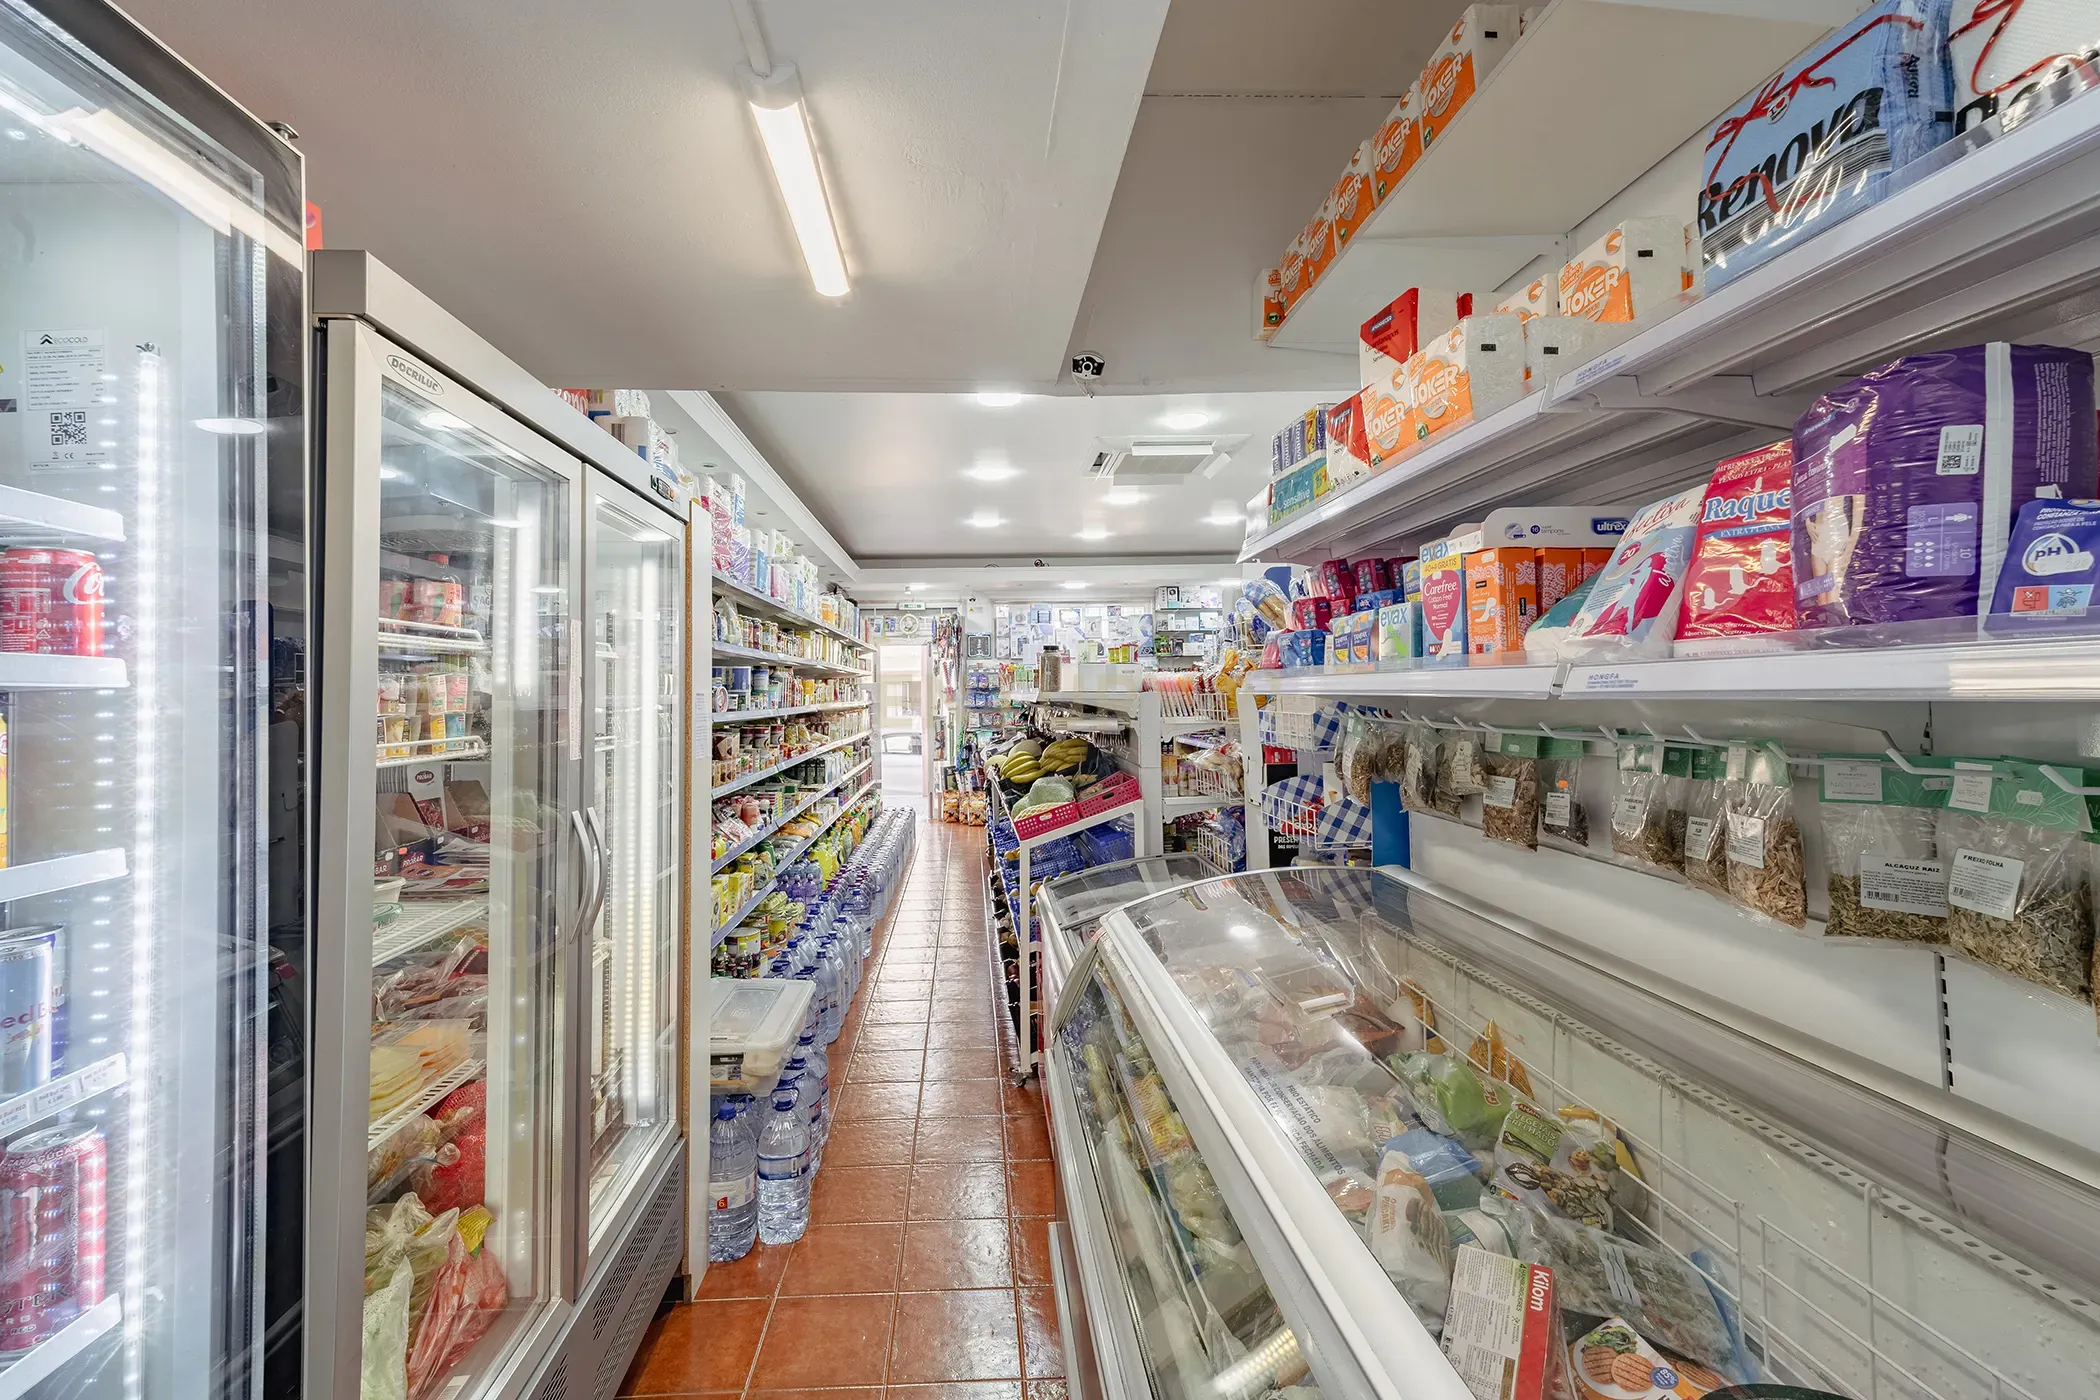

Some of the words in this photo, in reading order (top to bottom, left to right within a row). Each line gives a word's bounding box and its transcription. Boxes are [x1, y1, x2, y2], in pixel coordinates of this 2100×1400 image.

[1422, 53, 1463, 117] JOKER
[1374, 118, 1411, 172] JOKER
[1335, 173, 1363, 220] JOKER
[1562, 266, 1620, 317] JOKER
[390, 357, 439, 392] DOCRILUC
[1411, 364, 1460, 410] JOKER
[1596, 521, 1627, 531] ultrex
[1720, 528, 1748, 538] EXTRA
[1438, 557, 1457, 570] GRATIS
[1621, 546, 1635, 560] 20
[2034, 546, 2062, 562] pH
[1380, 607, 1408, 627] evax
[1884, 862, 1920, 871] ALCAÇUZ
[1963, 854, 1985, 864] FREIXO
[1986, 859, 2004, 868] FOLHA
[1286, 1084, 1300, 1098] FRIO
[1295, 1095, 1321, 1124] ESTÁTICO
[1262, 1090, 1274, 1103] POR
[1299, 1141, 1325, 1171] FECHADA
[1273, 1085, 1306, 1125] CONSERVAÇÃO
[1303, 1123, 1317, 1139] DOS
[1313, 1138, 1346, 1176] ALIMENTOS
[1506, 1117, 1560, 1151] GRELHADOS
[1514, 1112, 1557, 1140] VEGETAIS
[717, 1199, 726, 1208] 6
[1518, 1262, 1528, 1270] 4
[1529, 1269, 1550, 1313] Kilom
